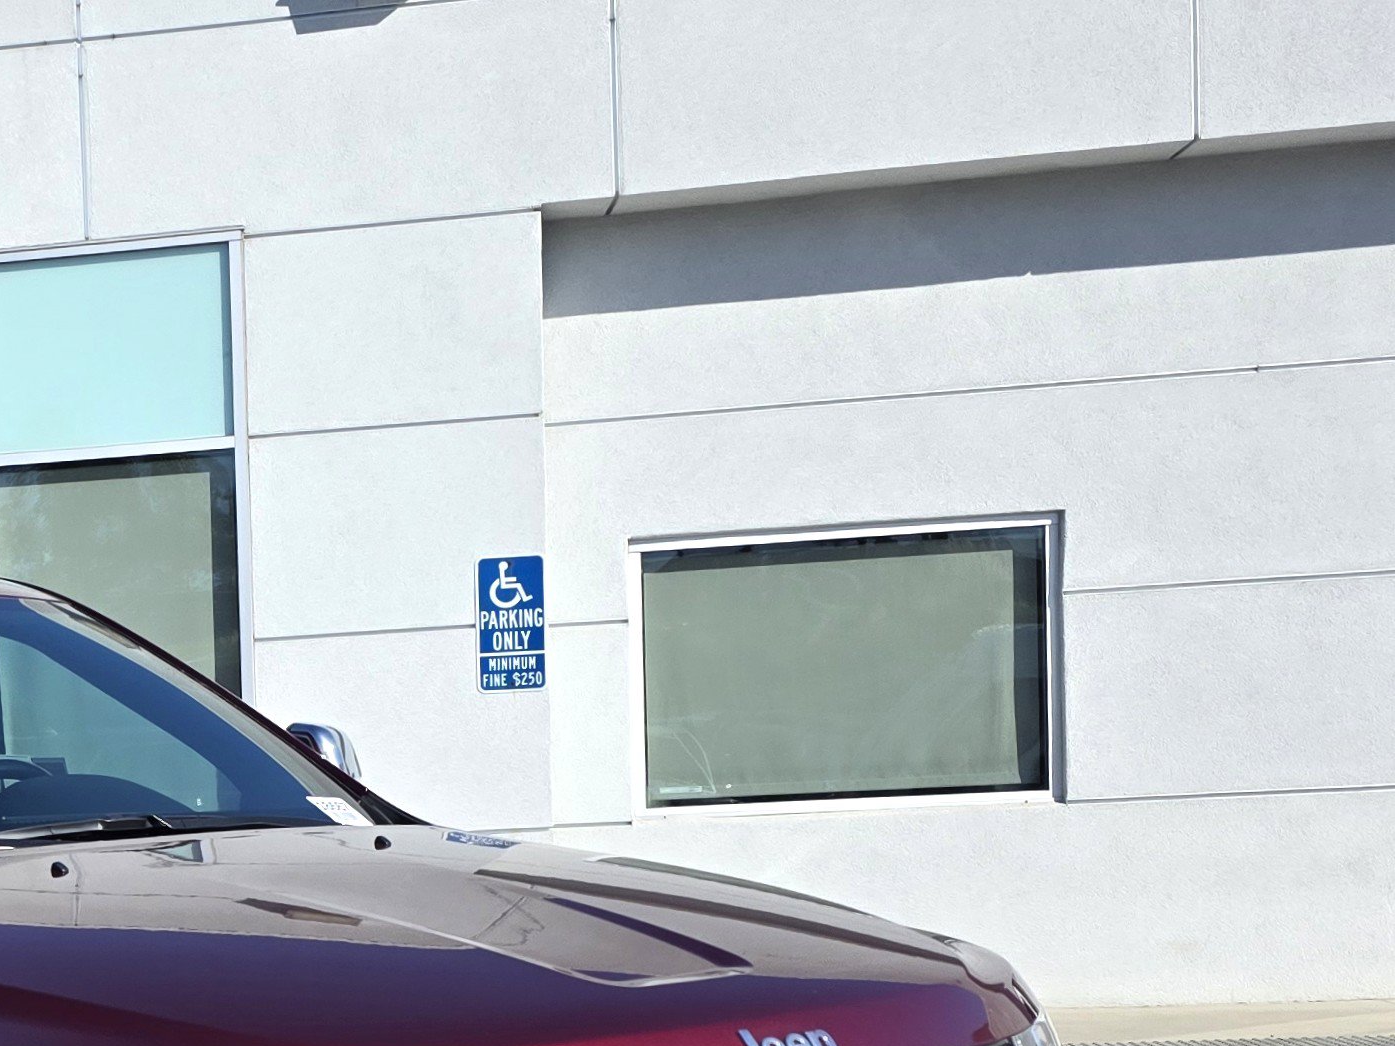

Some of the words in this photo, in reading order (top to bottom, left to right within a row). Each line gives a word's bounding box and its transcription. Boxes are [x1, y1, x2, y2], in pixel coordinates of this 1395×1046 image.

[480, 608, 543, 630] PARKING
[492, 630, 531, 651] ONLY
[488, 656, 537, 672] MINIMUM
[482, 673, 508, 688] FINE
[512, 671, 543, 687] $250
